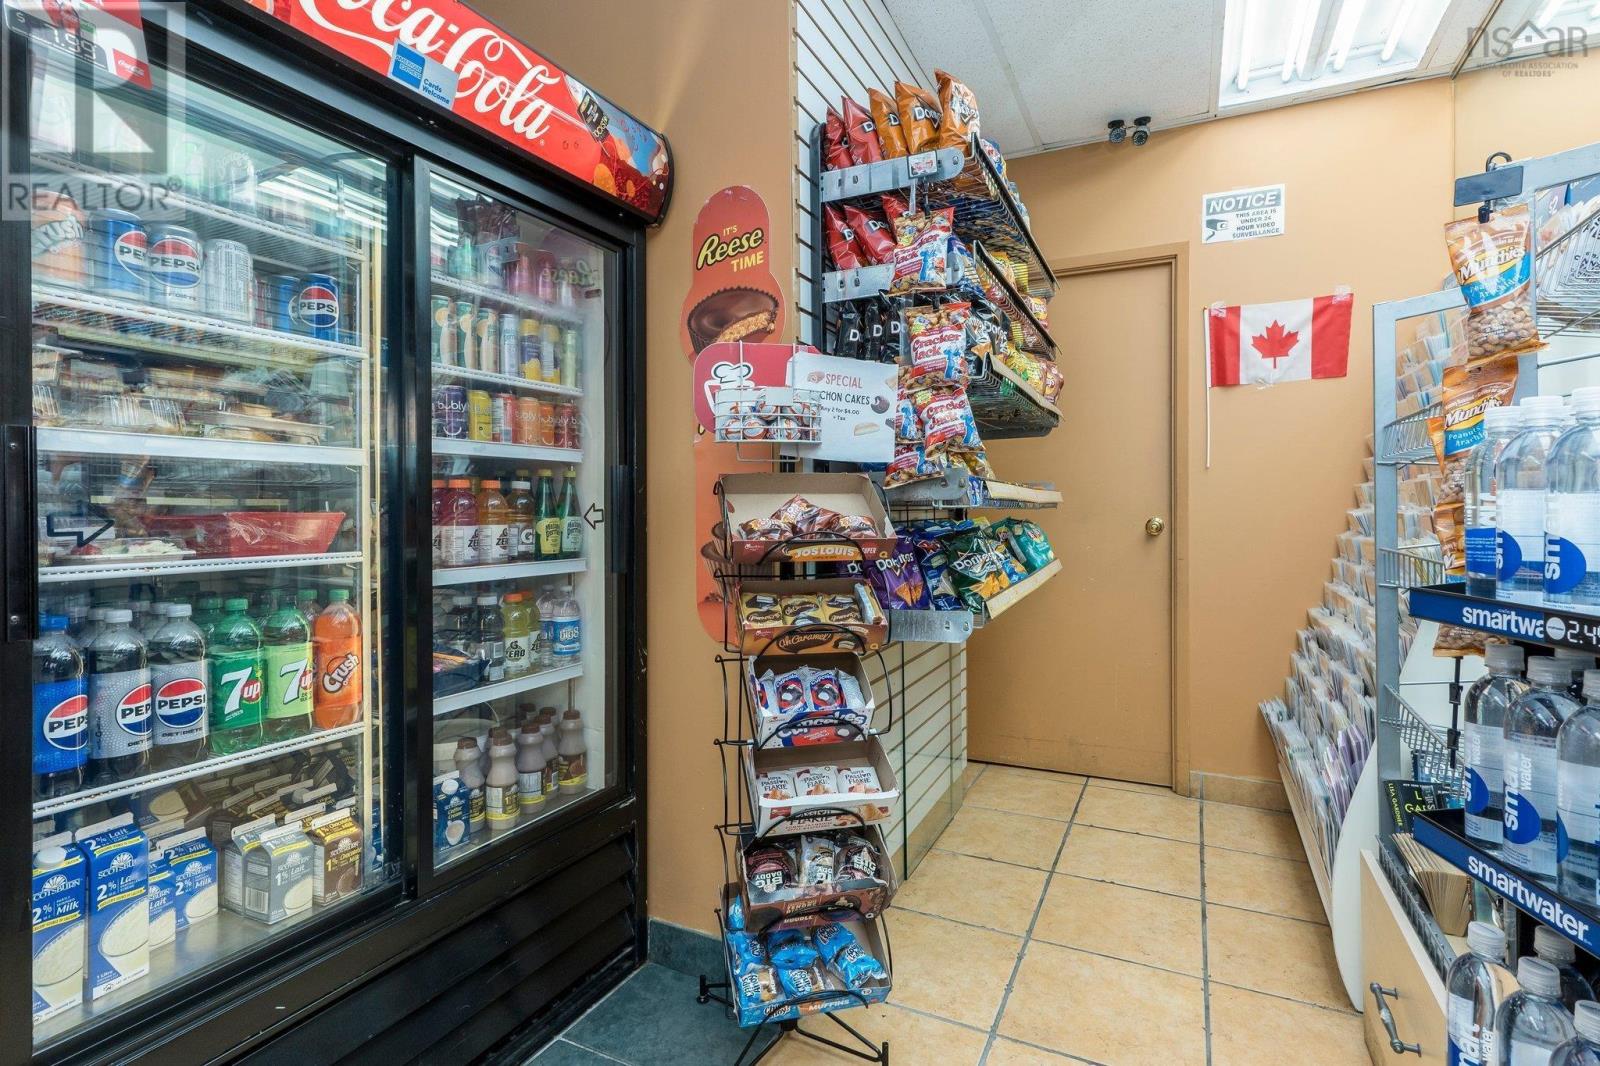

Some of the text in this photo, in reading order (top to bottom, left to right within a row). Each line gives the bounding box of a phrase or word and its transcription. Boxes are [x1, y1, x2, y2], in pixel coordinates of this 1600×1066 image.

[423, 78, 443, 94] Cards
[422, 84, 450, 105] Welcome
[1209, 191, 1279, 214] NOTICE
[1240, 216, 1262, 224] UNDER
[1251, 209, 1268, 217] AREA
[723, 224, 738, 237] IT'S
[1232, 227, 1280, 239] SURVEILLANCE
[696, 227, 764, 271] Reese
[730, 251, 765, 273] TIME
[912, 332, 962, 350] Cracker
[914, 346, 941, 363] Jack
[825, 373, 863, 389] SPECIAL
[844, 393, 871, 405] CAKES
[1448, 425, 1481, 441] Peanuts
[819, 546, 856, 558] LOUIS
[322, 652, 359, 694] Crush
[157, 694, 206, 710] PEPSI
[853, 855, 876, 871] BIG
[194, 877, 213, 889] Milk
[1467, 854, 1589, 942] smartwater
[56, 900, 80, 916] Milk
[808, 998, 850, 1012] MUFFINS
